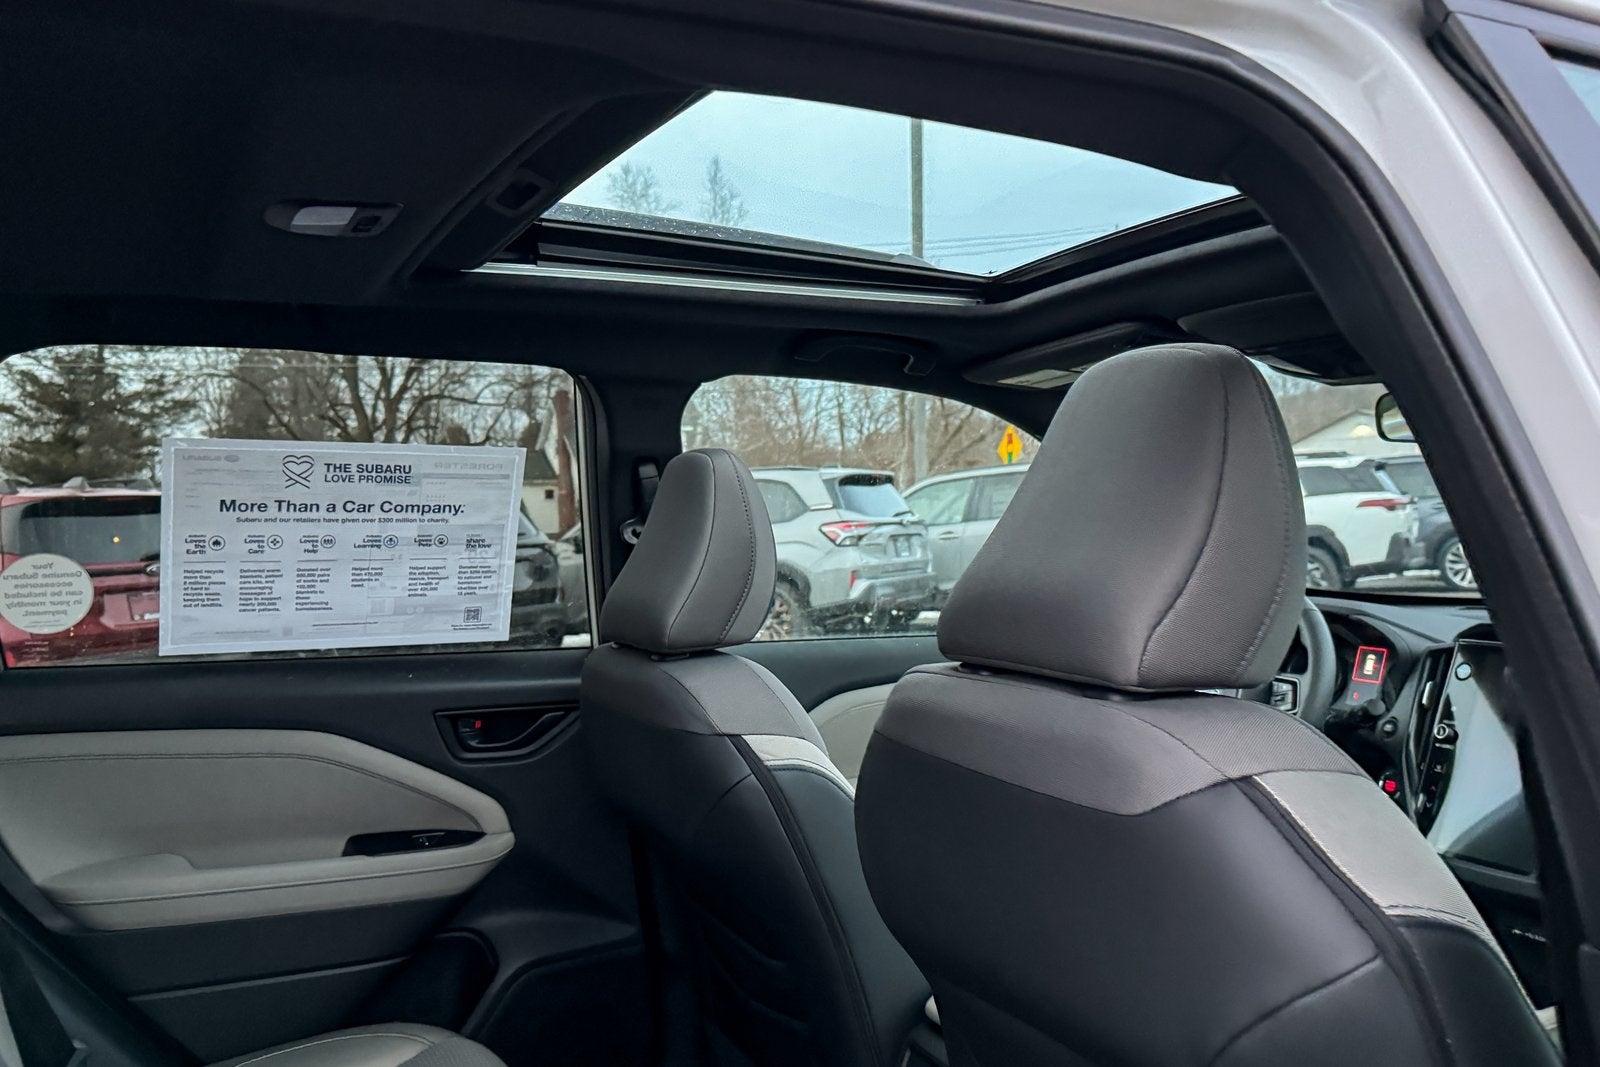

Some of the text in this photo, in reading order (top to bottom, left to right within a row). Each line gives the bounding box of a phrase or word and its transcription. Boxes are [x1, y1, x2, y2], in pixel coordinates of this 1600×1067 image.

[324, 463, 412, 474] THE SUBARU
[324, 474, 412, 484] LOVE PROMISE
[219, 499, 268, 512] More
[274, 500, 320, 512] Than
[326, 503, 336, 512] a
[342, 500, 375, 513] Car
